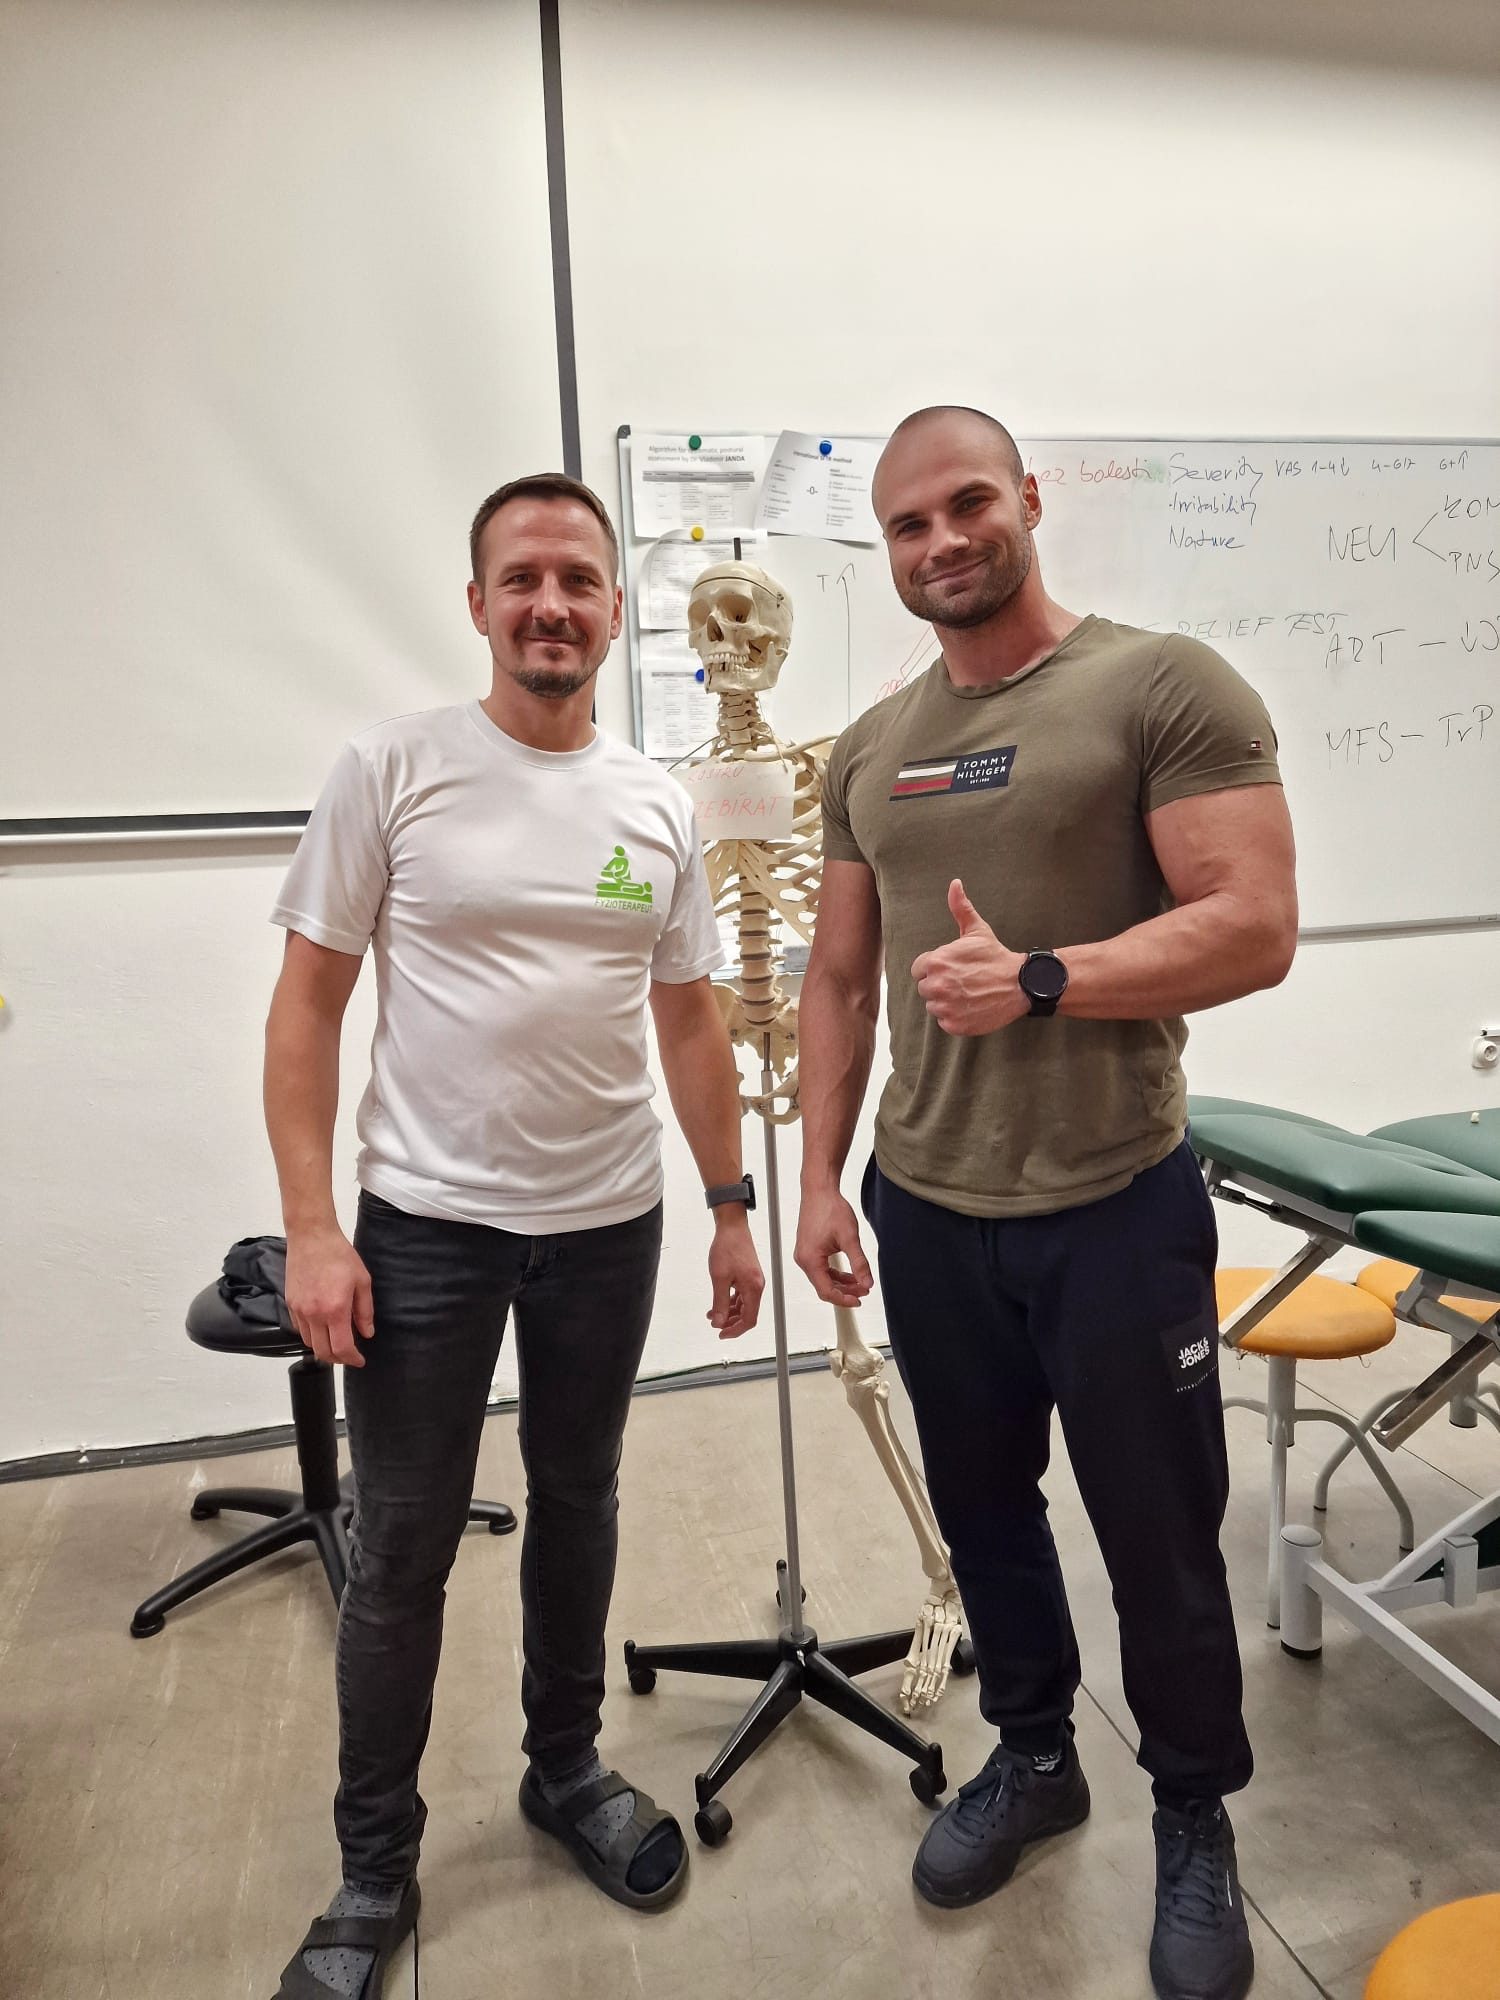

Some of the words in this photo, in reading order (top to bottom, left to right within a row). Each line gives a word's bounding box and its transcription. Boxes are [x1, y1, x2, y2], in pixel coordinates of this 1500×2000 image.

[1276, 459, 1302, 477] VAS
[1168, 524, 1246, 549] Nature
[962, 755, 1008, 769] TOMMY
[957, 765, 1007, 780] HILFIGER
[595, 898, 653, 914] FYZIOTERAPEUT
[1180, 1346, 1210, 1369] JONES
